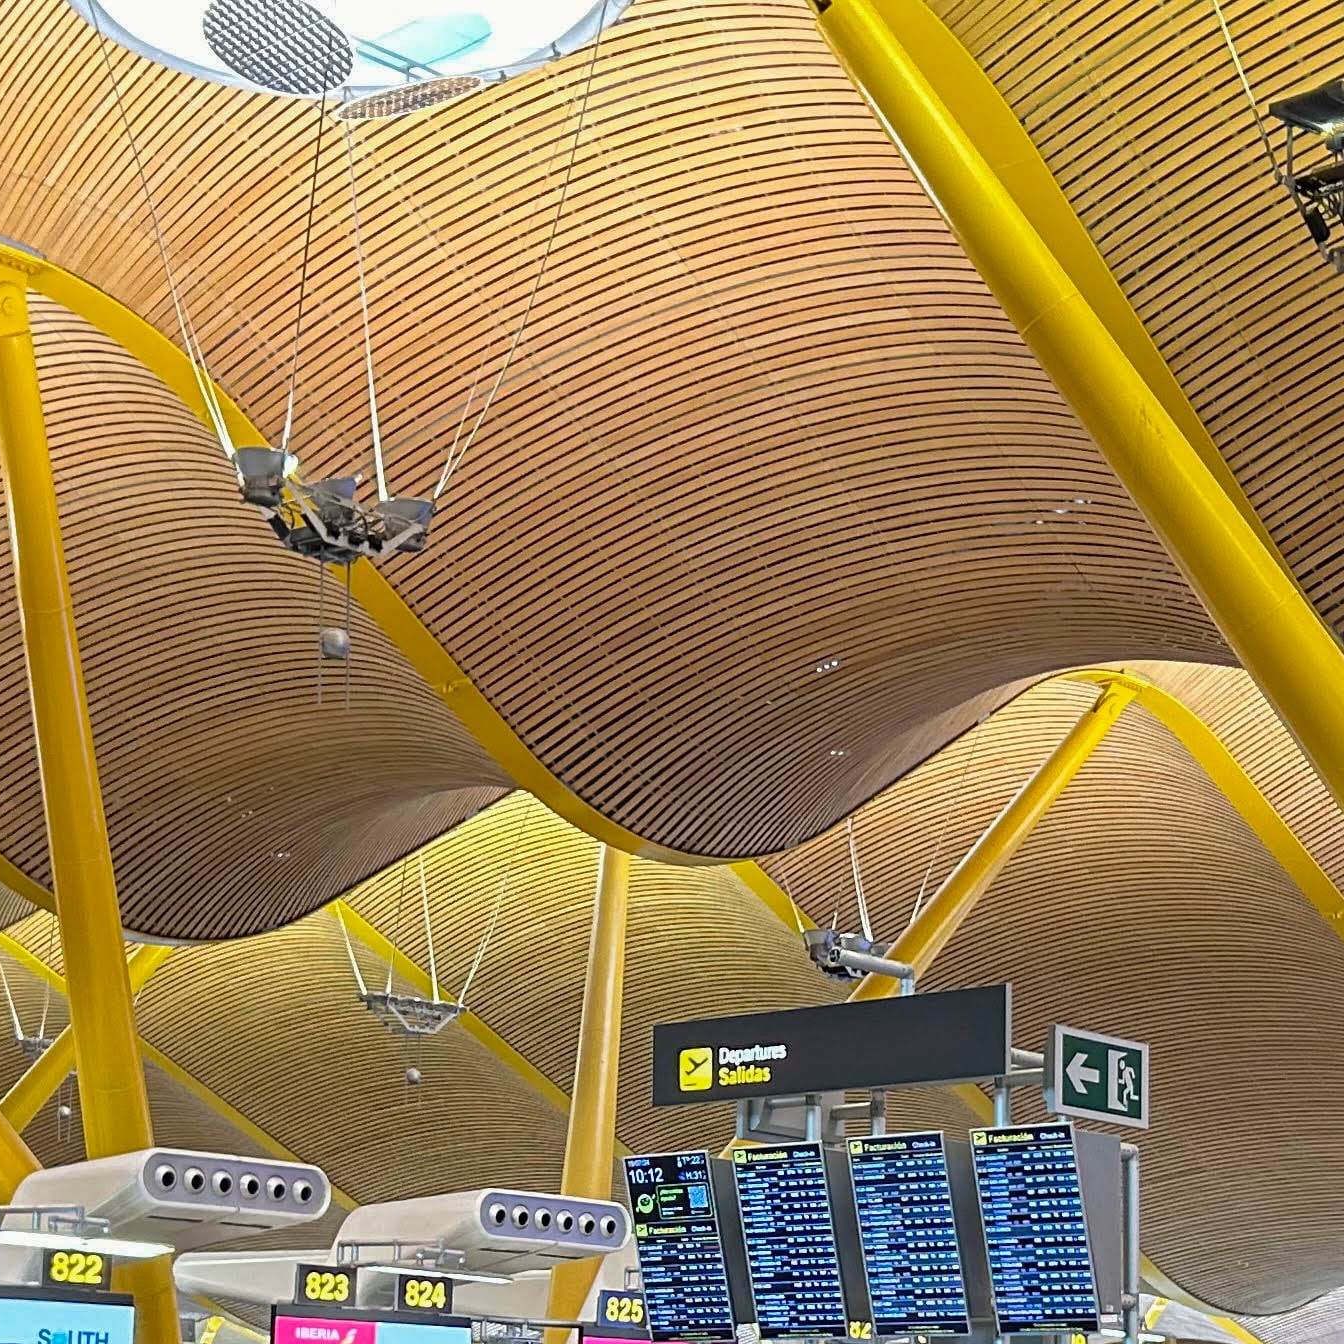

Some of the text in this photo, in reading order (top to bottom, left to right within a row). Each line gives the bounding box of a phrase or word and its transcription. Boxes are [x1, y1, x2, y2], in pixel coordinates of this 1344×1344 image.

[718, 1044, 787, 1066] Departures
[718, 1065, 771, 1086] Salidas
[864, 1141, 907, 1151] Facturación
[988, 1132, 1034, 1143] Facturación
[748, 1151, 788, 1161] Facturación
[629, 1168, 665, 1184] 10:12
[50, 1251, 104, 1284] 822
[305, 1271, 350, 1301] 823
[405, 1279, 446, 1308] 824
[606, 1296, 644, 1323] 825
[295, 1327, 340, 1341] IBERIA
